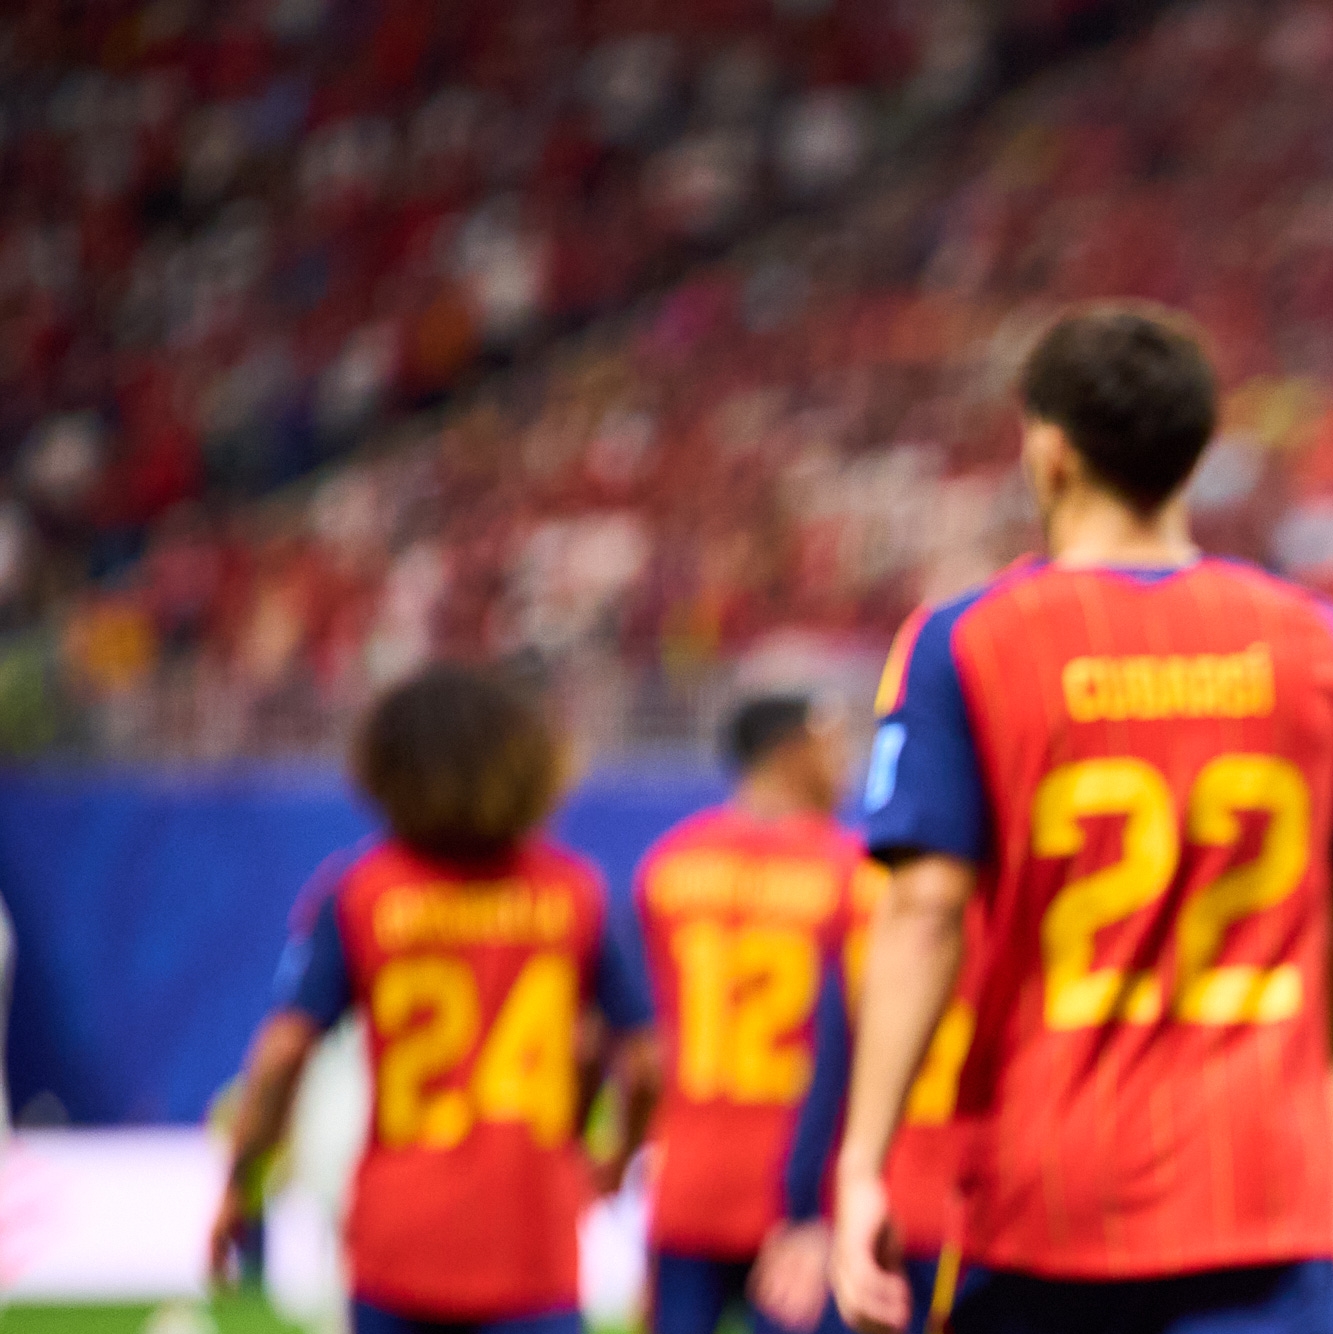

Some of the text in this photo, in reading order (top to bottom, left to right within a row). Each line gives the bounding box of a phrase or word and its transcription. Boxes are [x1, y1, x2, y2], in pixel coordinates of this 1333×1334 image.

[1030, 753, 1312, 1031] 22
[373, 950, 579, 1150] 24
[672, 915, 822, 1104] 12
